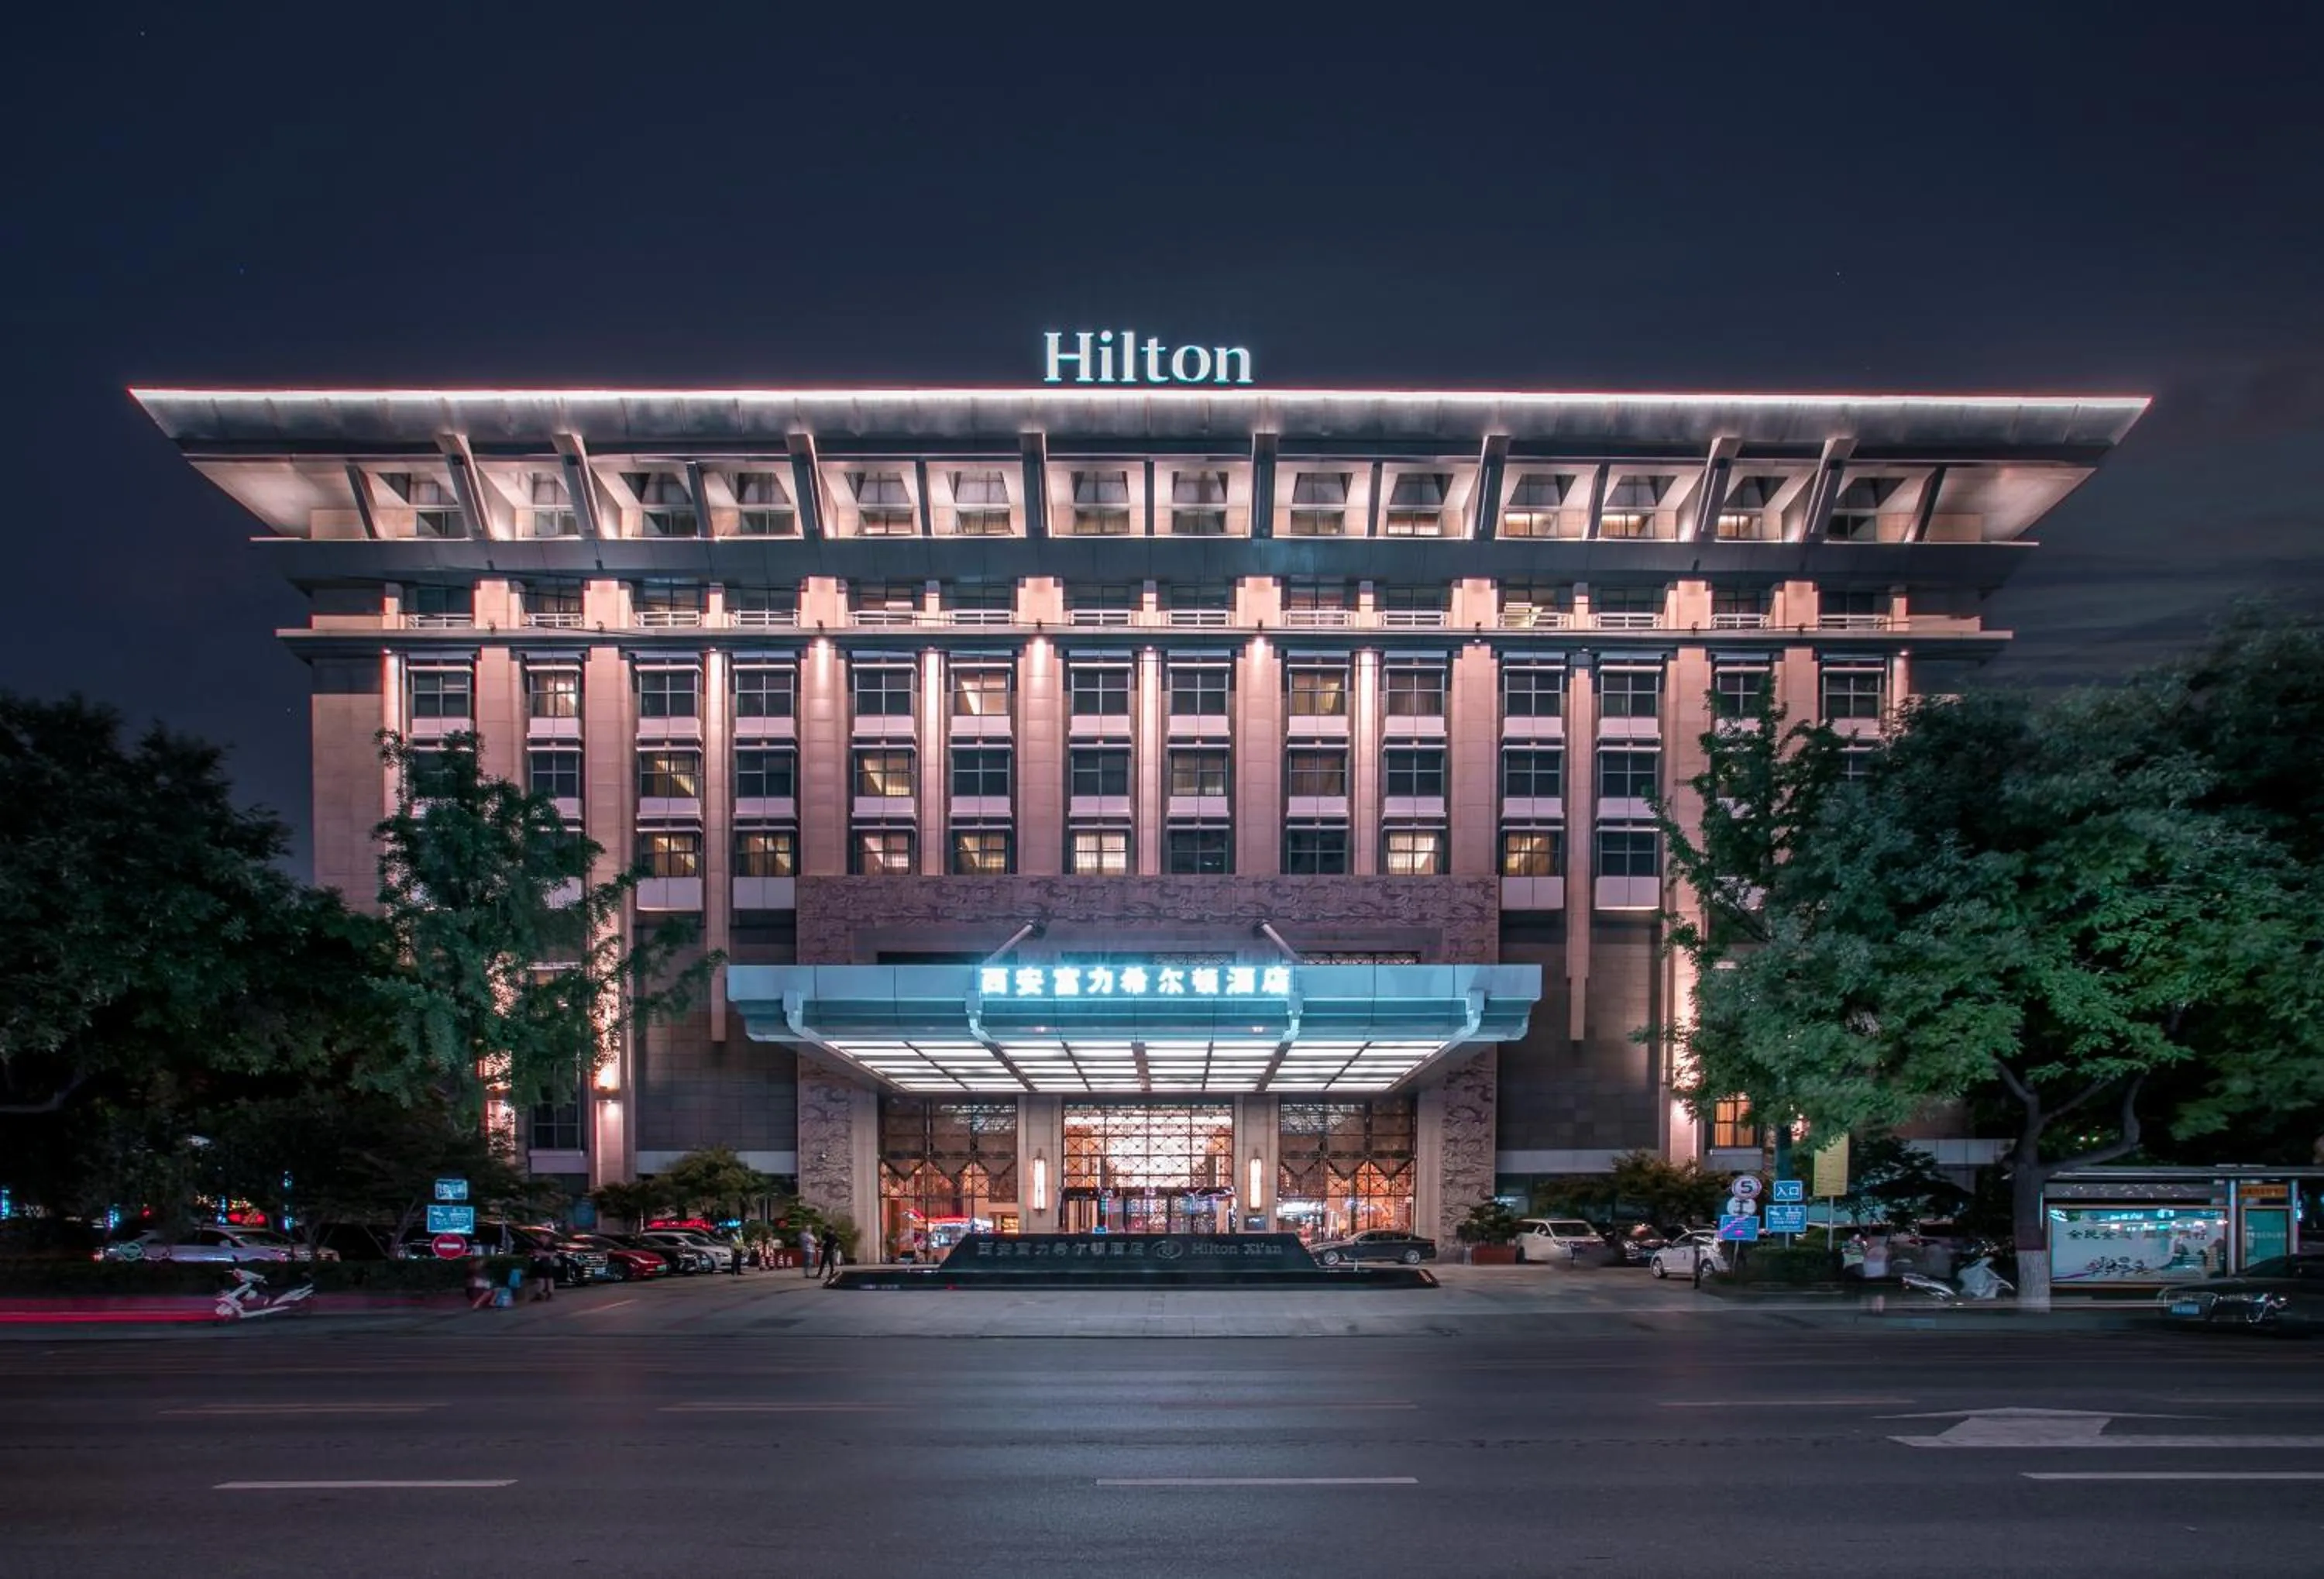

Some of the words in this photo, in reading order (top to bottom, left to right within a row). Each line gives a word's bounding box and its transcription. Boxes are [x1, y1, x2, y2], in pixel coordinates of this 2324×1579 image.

[1043, 330, 1253, 382] Hilton
[981, 966, 1290, 996] 西安富力希尔顿酒店
[1776, 1186, 1800, 1197] 入口
[1191, 1242, 1238, 1255] Hilton
